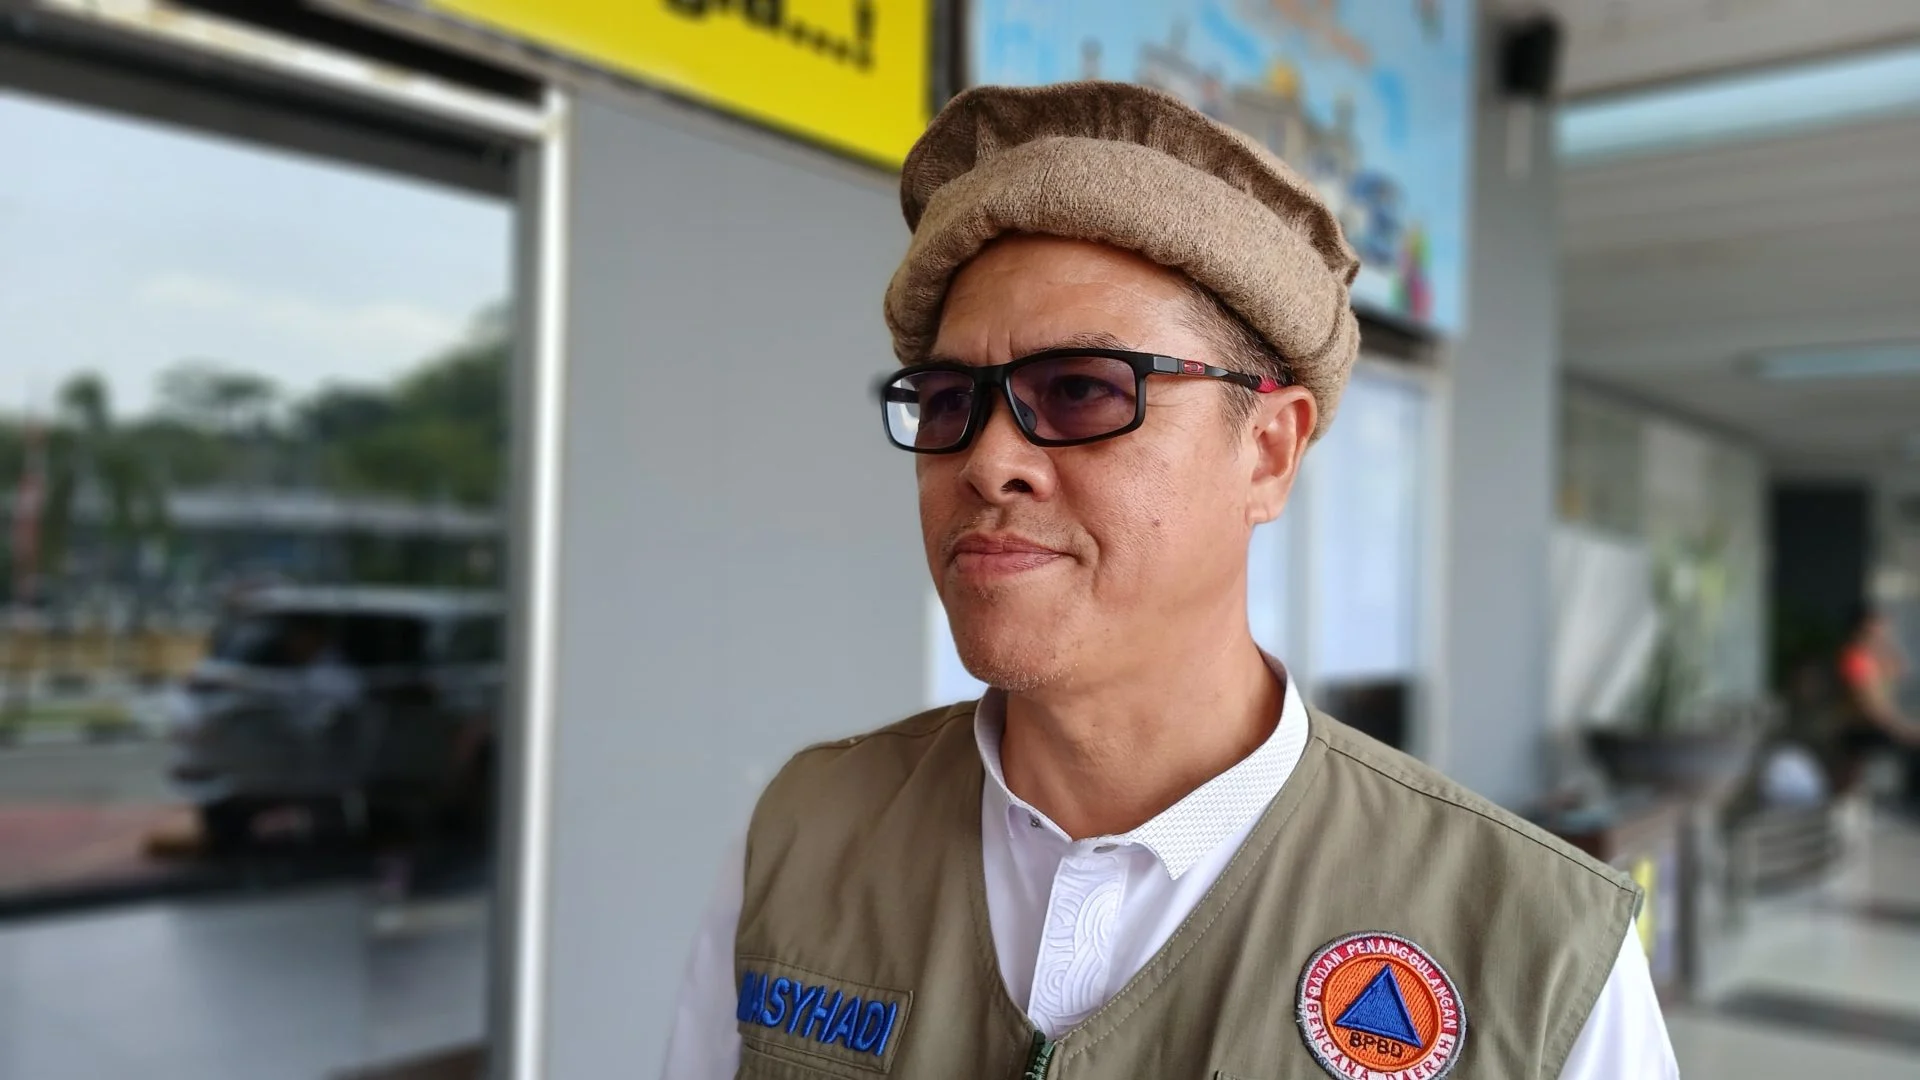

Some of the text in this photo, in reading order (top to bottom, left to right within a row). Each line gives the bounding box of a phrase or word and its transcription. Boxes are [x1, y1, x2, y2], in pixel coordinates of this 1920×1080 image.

[1308, 939, 1458, 1030] BADAN PENANGGULANGAN
[1307, 1003, 1369, 1080] BENCANA
[1349, 1031, 1403, 1058] BPBD
